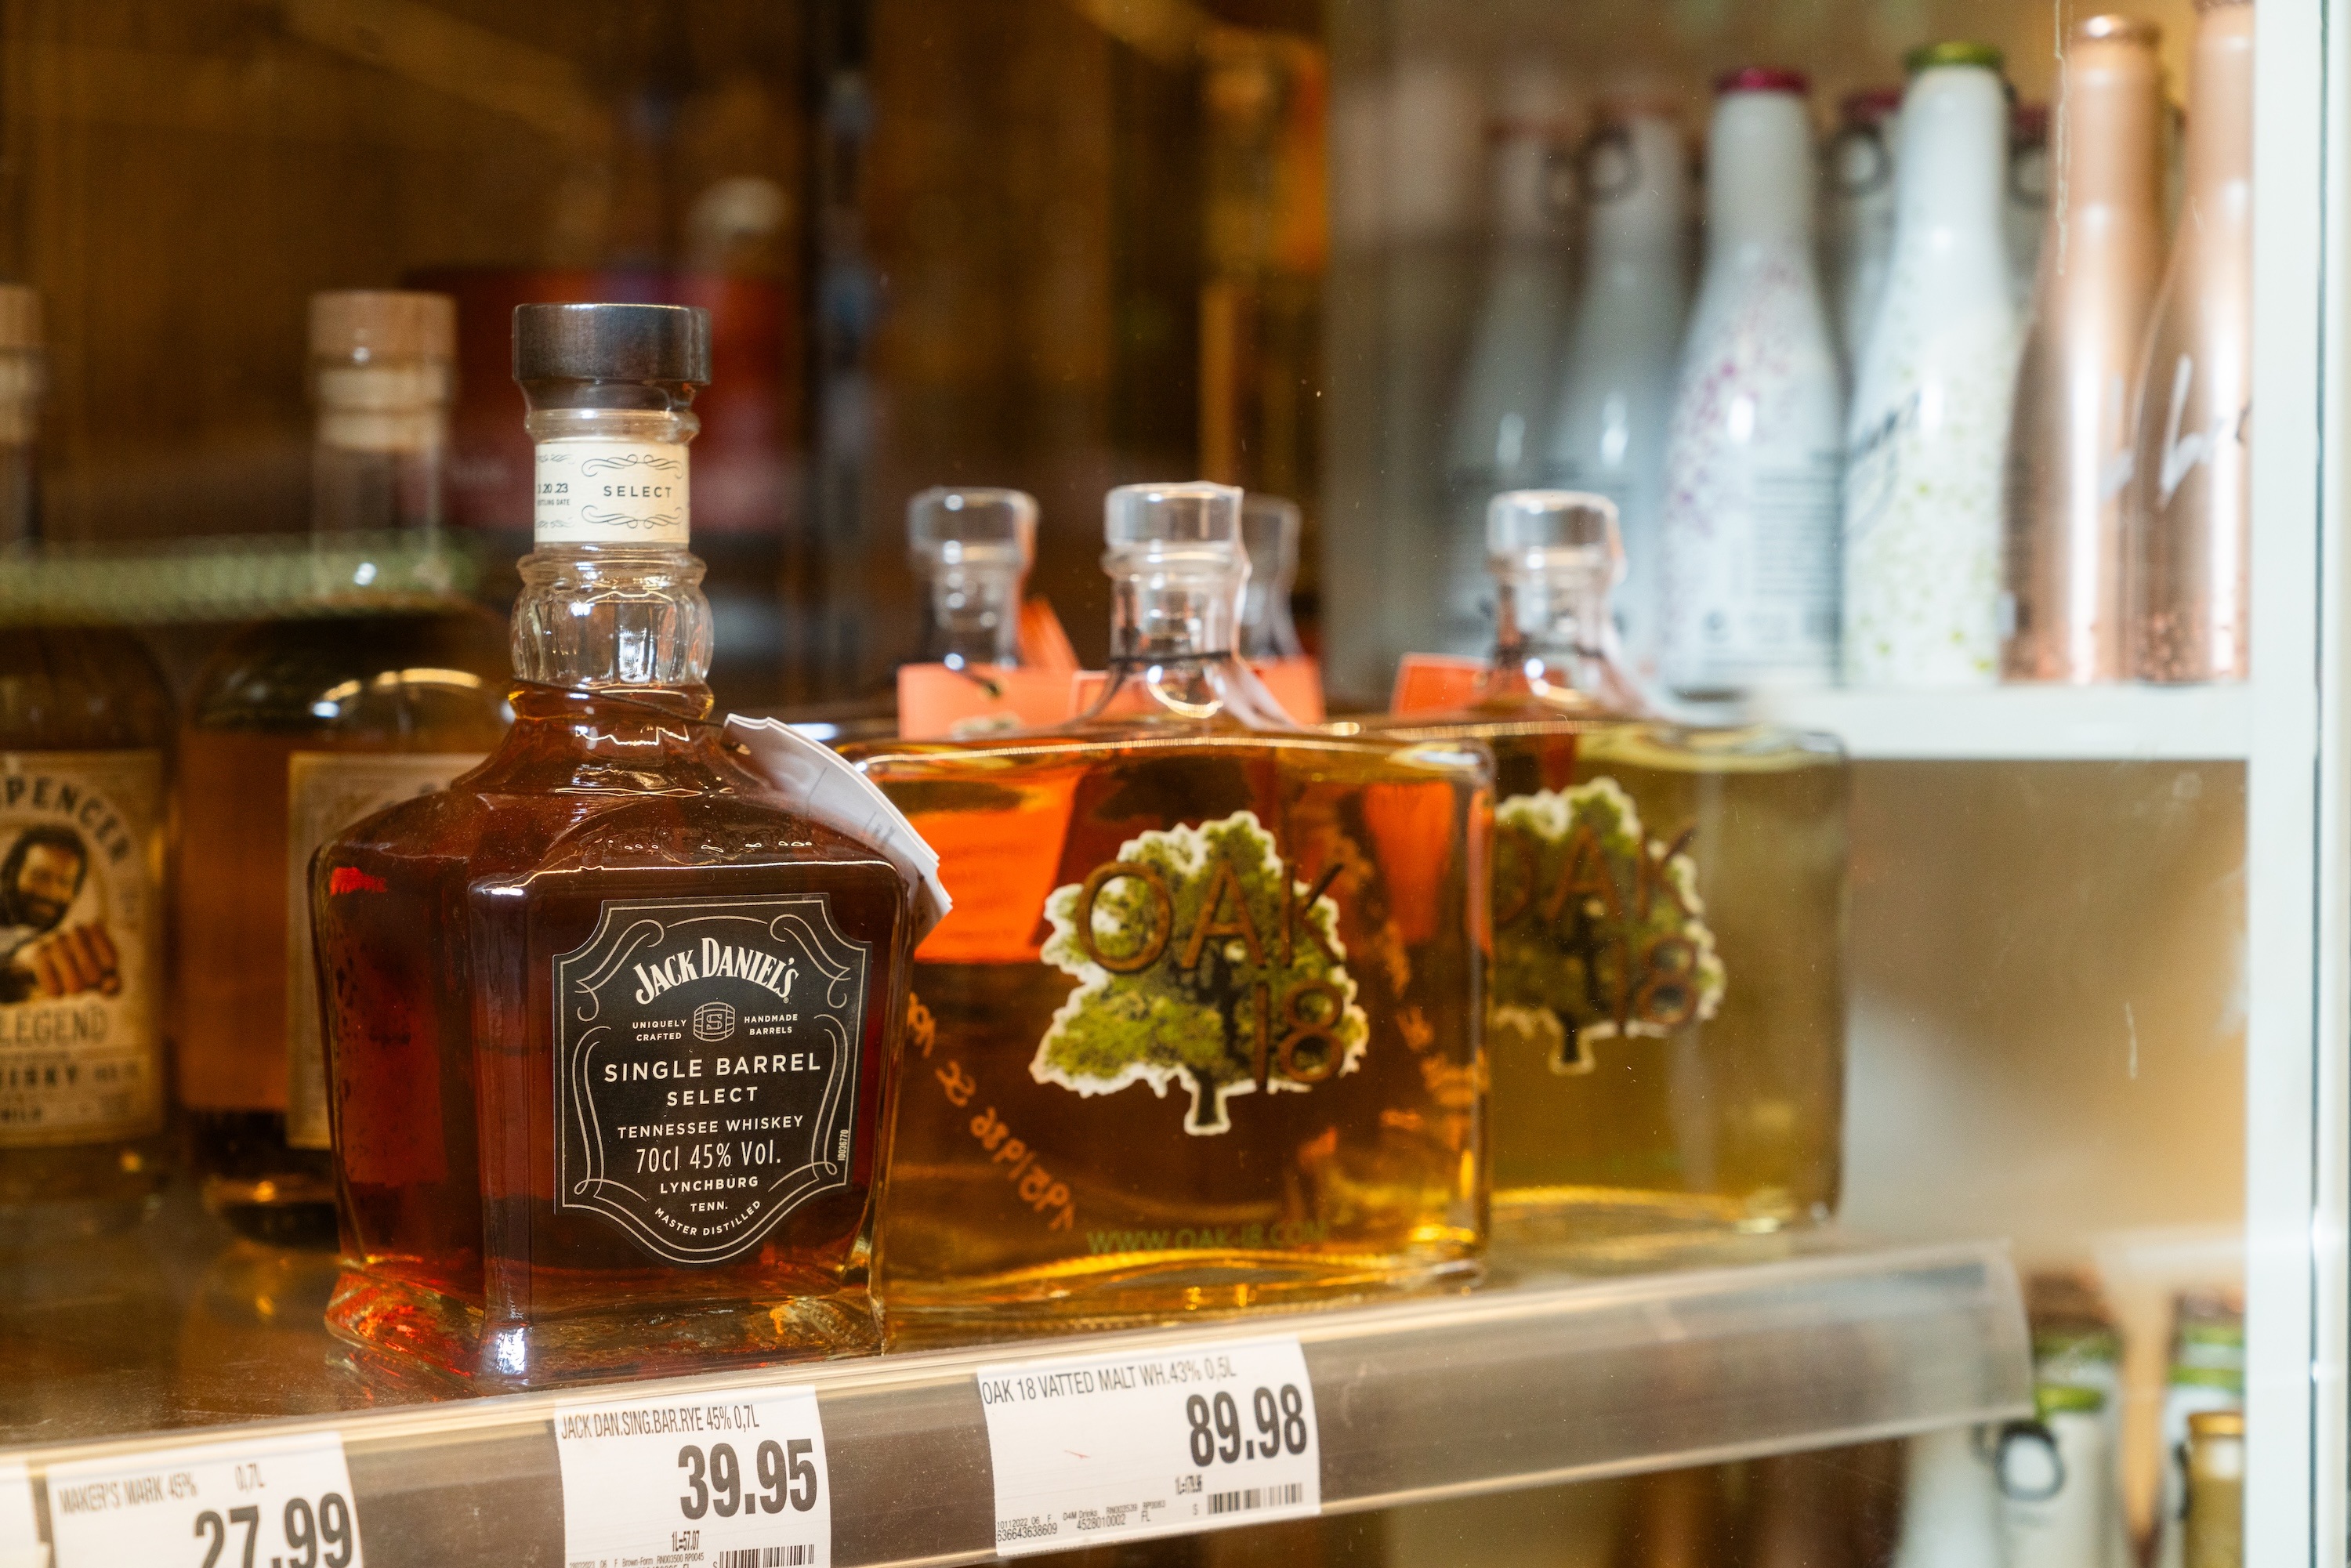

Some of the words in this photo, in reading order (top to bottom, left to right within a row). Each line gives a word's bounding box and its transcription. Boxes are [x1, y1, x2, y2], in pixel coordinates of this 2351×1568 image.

[603, 485, 672, 498] SELECT
[1076, 860, 1345, 974] OAK
[633, 949, 699, 1005] JACK
[701, 936, 799, 1000] DANIEL'S
[632, 1019, 686, 1029] UNIQUELY
[744, 1014, 798, 1023] HANDMADE
[749, 1027, 792, 1036] BARRELS
[636, 1032, 682, 1041] CRAFTED
[1255, 980, 1345, 1092] 18
[604, 1058, 703, 1083] SINGLE
[716, 1052, 821, 1077] BARREL
[667, 1086, 759, 1106] SELECT
[618, 1121, 719, 1139] TENNESSEE
[726, 1114, 804, 1132] WHISKEY
[690, 1143, 732, 1169] 45%
[741, 1139, 782, 1166] Vol.
[660, 1175, 759, 1194] LYNCHBURG
[654, 1208, 697, 1237] MASTER
[702, 1200, 762, 1237] DISTILLED
[690, 1200, 728, 1212] TENN.
[982, 1378, 1014, 1406] OAK
[1017, 1376, 1037, 1402] 18
[1040, 1370, 1096, 1399] VATTED
[1099, 1366, 1135, 1392] MALT
[1204, 1356, 1237, 1383] 0,5L
[561, 1412, 593, 1440] JACK
[594, 1406, 704, 1439] DAN.SING.BAR.RYE
[706, 1405, 732, 1432] 45%
[734, 1403, 759, 1433] 0,7L
[1186, 1383, 1307, 1468] 89.98
[678, 1438, 817, 1520] 39.95
[1078, 1508, 1098, 1519] Drinks
[194, 1491, 353, 1568] 27.99
[672, 1529, 700, 1552] 1L=57.07
